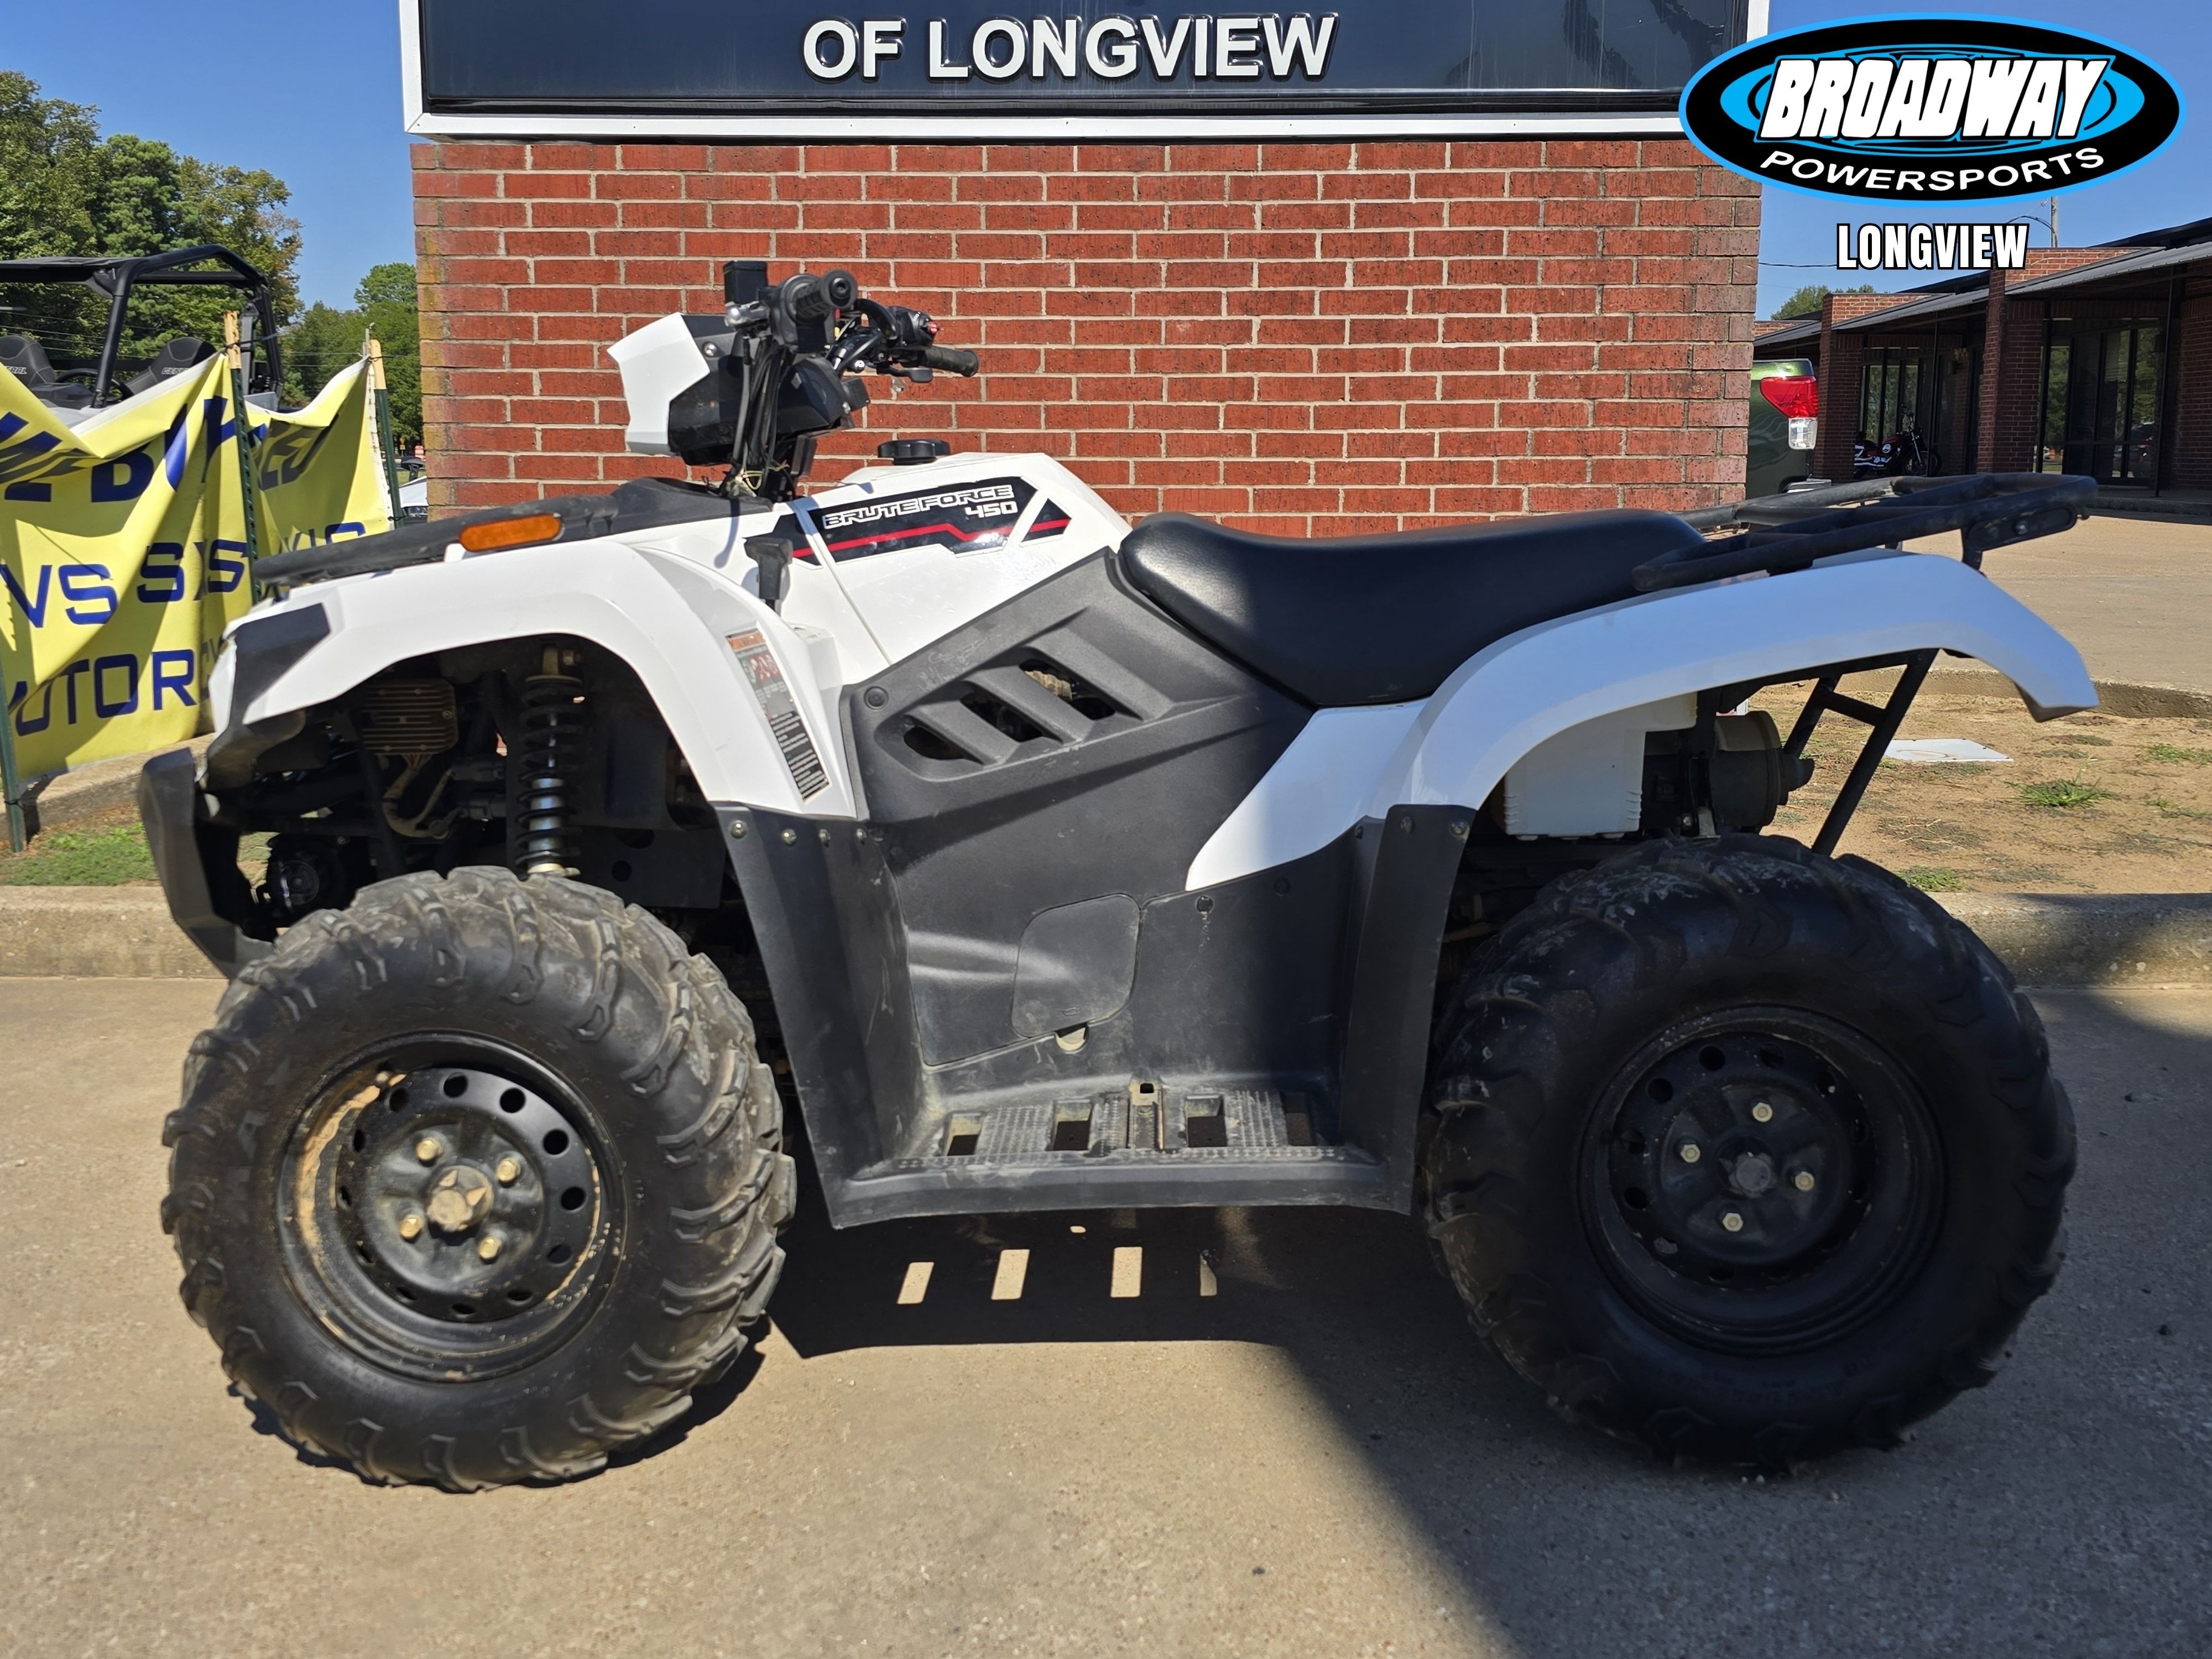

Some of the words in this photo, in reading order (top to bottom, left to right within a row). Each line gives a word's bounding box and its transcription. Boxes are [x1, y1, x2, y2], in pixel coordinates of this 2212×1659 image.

[803, 18, 906, 81] OF
[929, 14, 1336, 81] LONGVIEW
[964, 500, 1018, 519] 450
